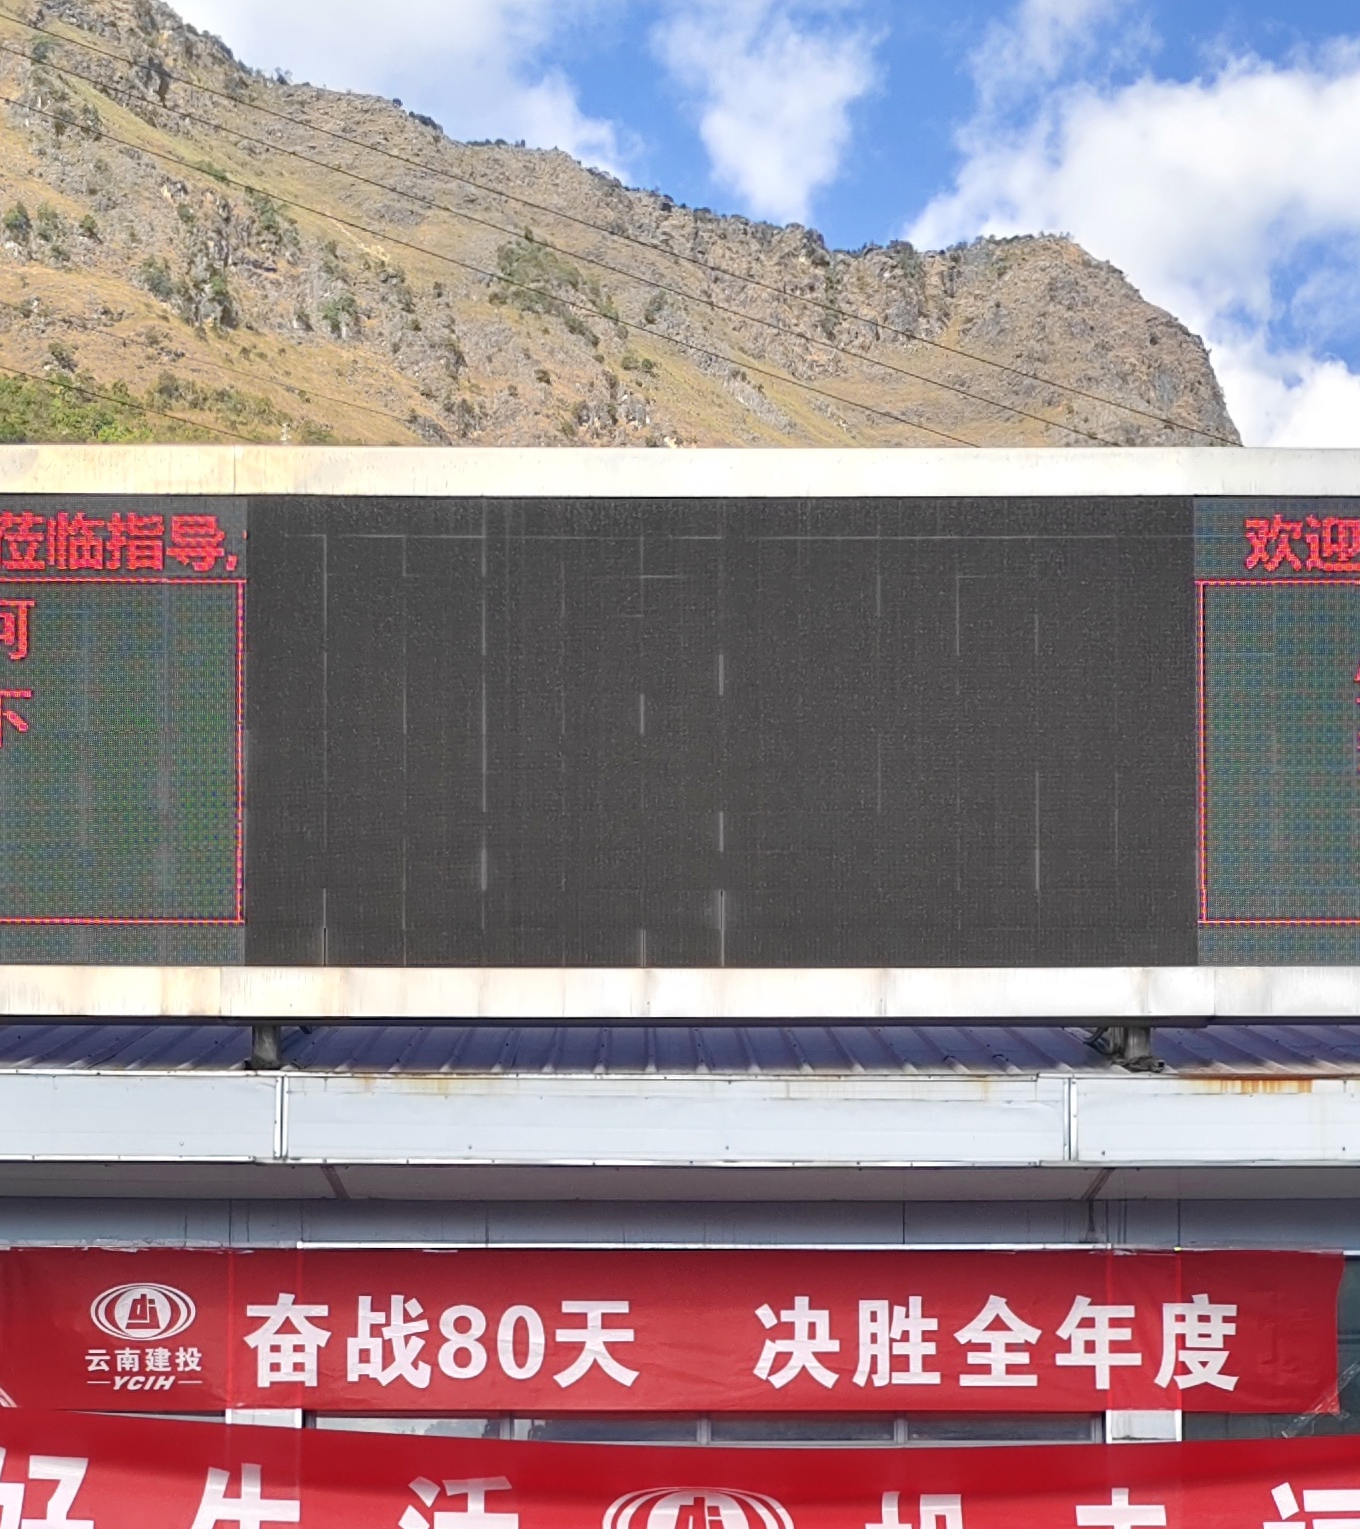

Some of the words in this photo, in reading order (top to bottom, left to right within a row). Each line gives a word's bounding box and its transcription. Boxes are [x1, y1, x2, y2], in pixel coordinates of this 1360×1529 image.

[242, 1292, 640, 1389] 奋战80天
[752, 1293, 1240, 1391] 决胜全年度
[84, 1345, 203, 1374] 云南建投
[111, 1375, 175, 1391] YCIH
